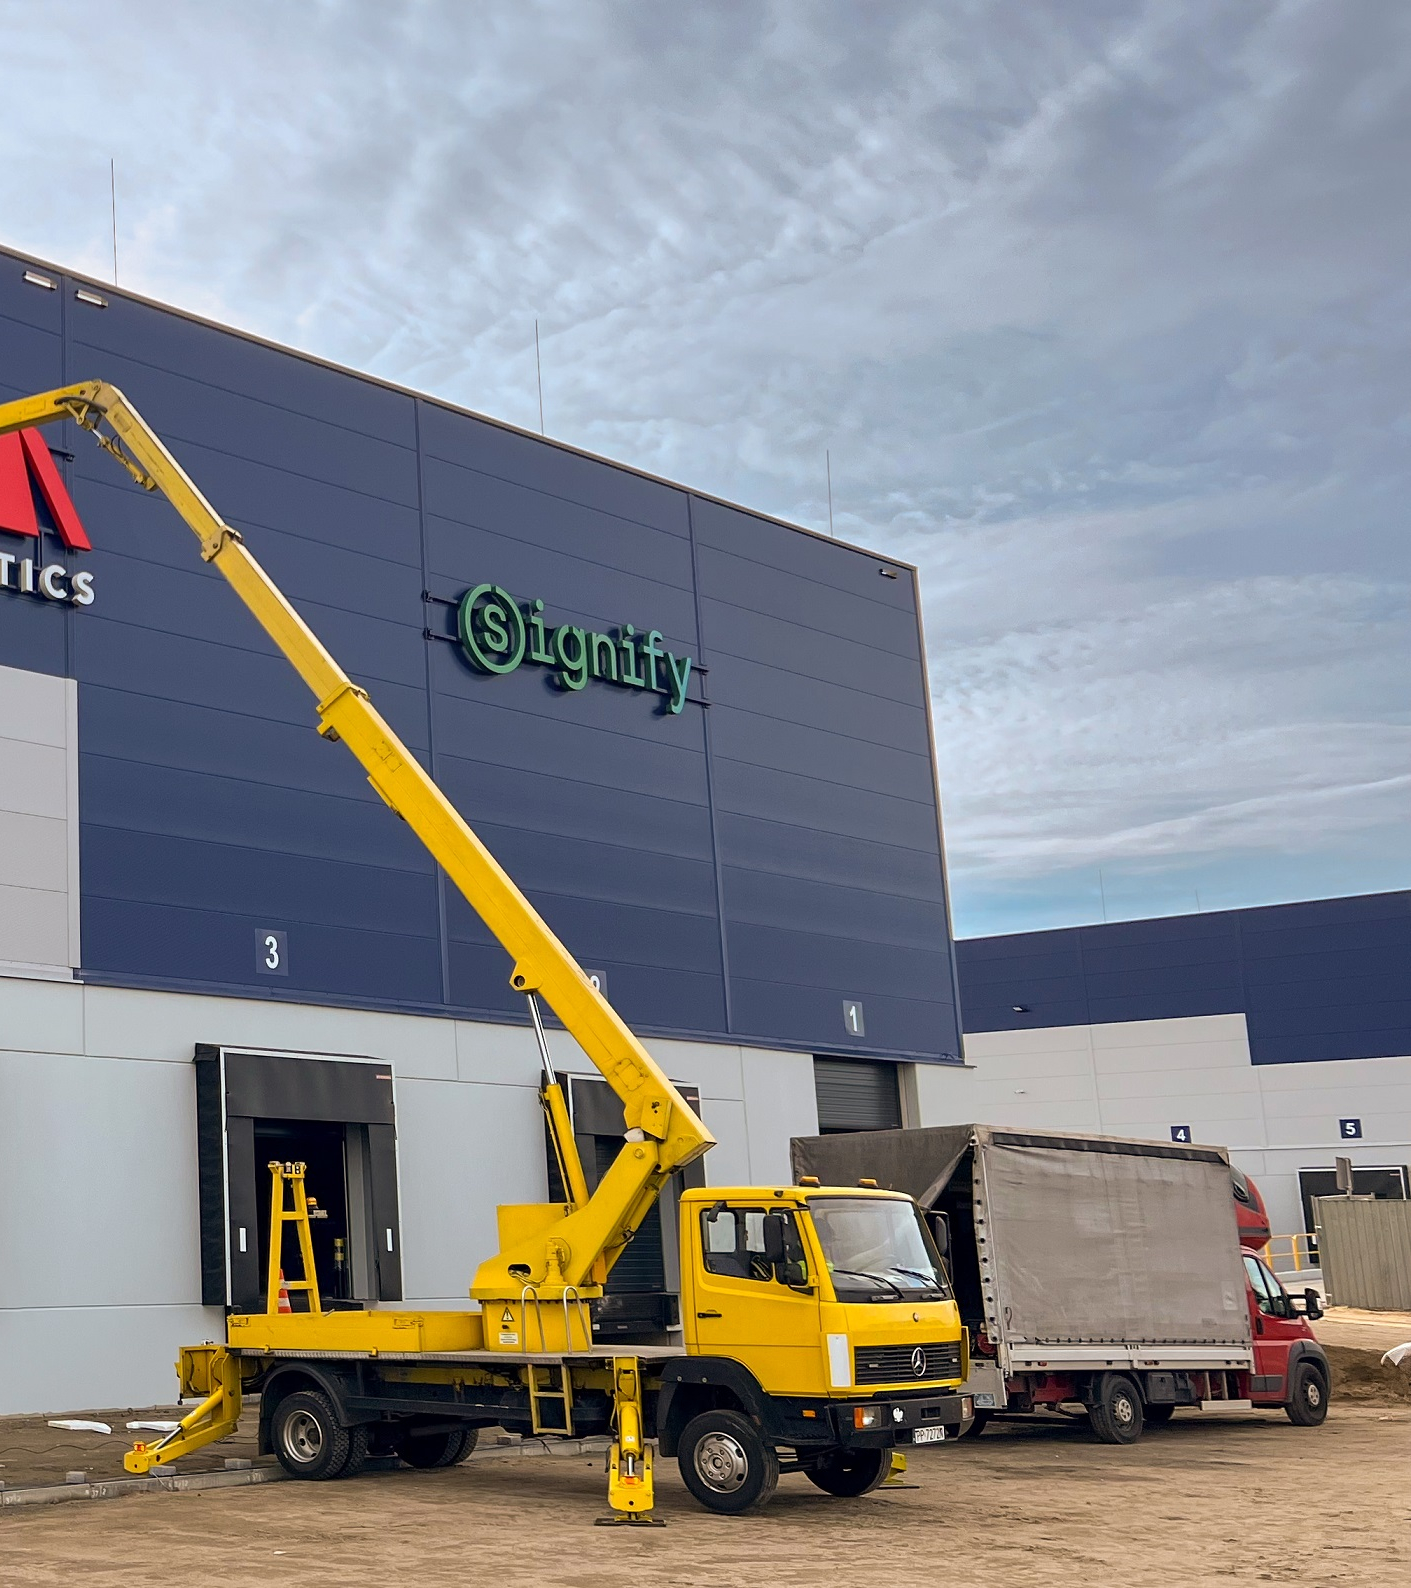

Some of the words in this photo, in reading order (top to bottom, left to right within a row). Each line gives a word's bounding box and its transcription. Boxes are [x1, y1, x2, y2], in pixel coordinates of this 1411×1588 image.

[264, 935, 280, 970] 3
[849, 1005, 858, 1032] 1
[1176, 1128, 1186, 1142] 4
[1345, 1122, 1356, 1136] 5
